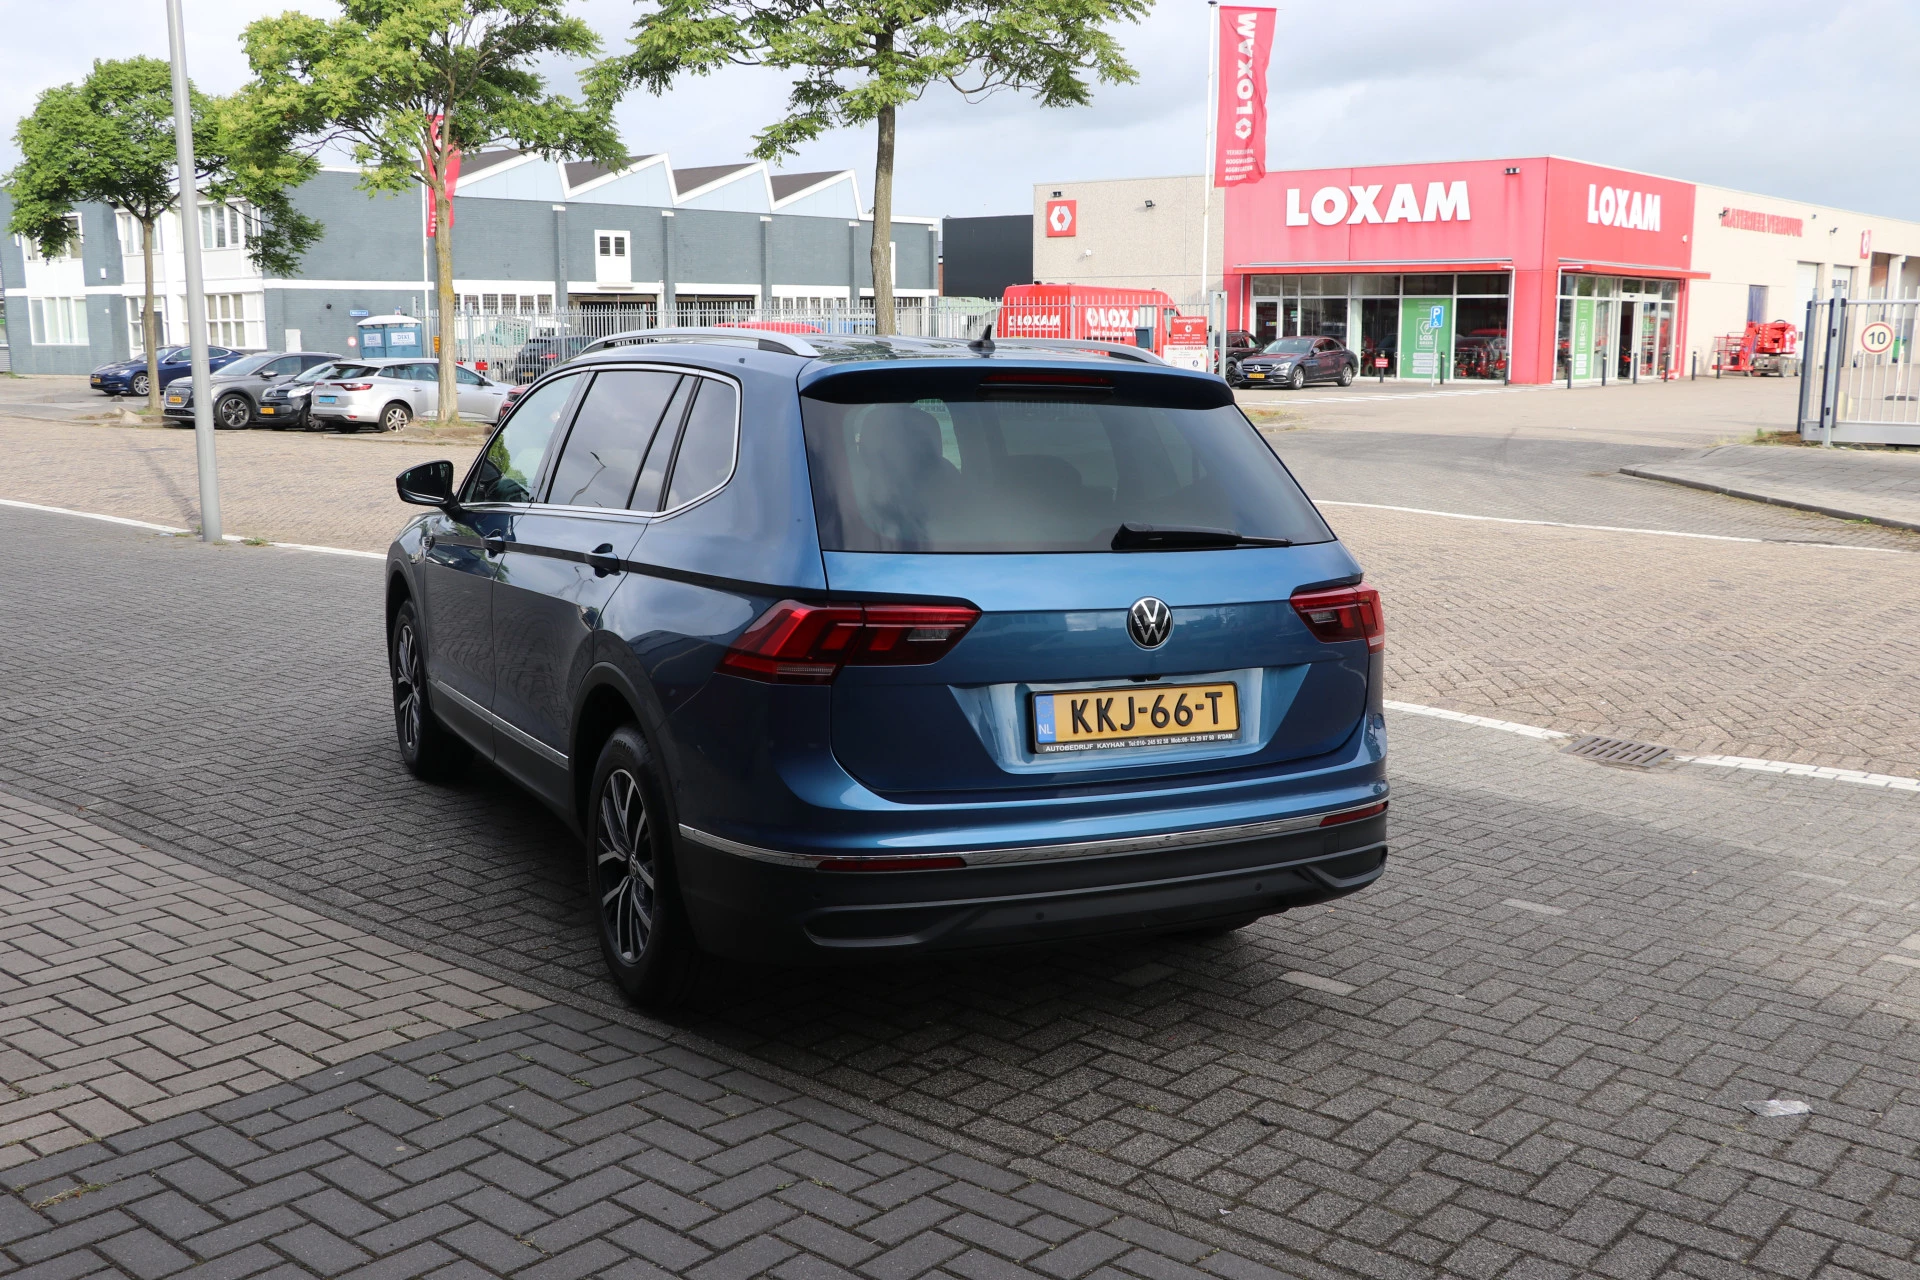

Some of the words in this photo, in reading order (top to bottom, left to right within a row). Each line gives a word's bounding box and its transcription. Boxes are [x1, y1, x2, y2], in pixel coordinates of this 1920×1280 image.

[1236, 12, 1258, 115] LOXAM
[1286, 180, 1471, 227] LOXAM
[1587, 183, 1661, 232] LOXAM
[1017, 314, 1061, 326] LOXAM
[1098, 307, 1140, 328] LOXA
[1433, 308, 1441, 319] P
[1868, 331, 1886, 345] 10
[1071, 691, 1223, 734] KKJ-66-T
[1038, 723, 1053, 735] NL
[1045, 743, 1094, 752] AUTOBEDRIJF
[1096, 741, 1125, 749] KAYHAN
